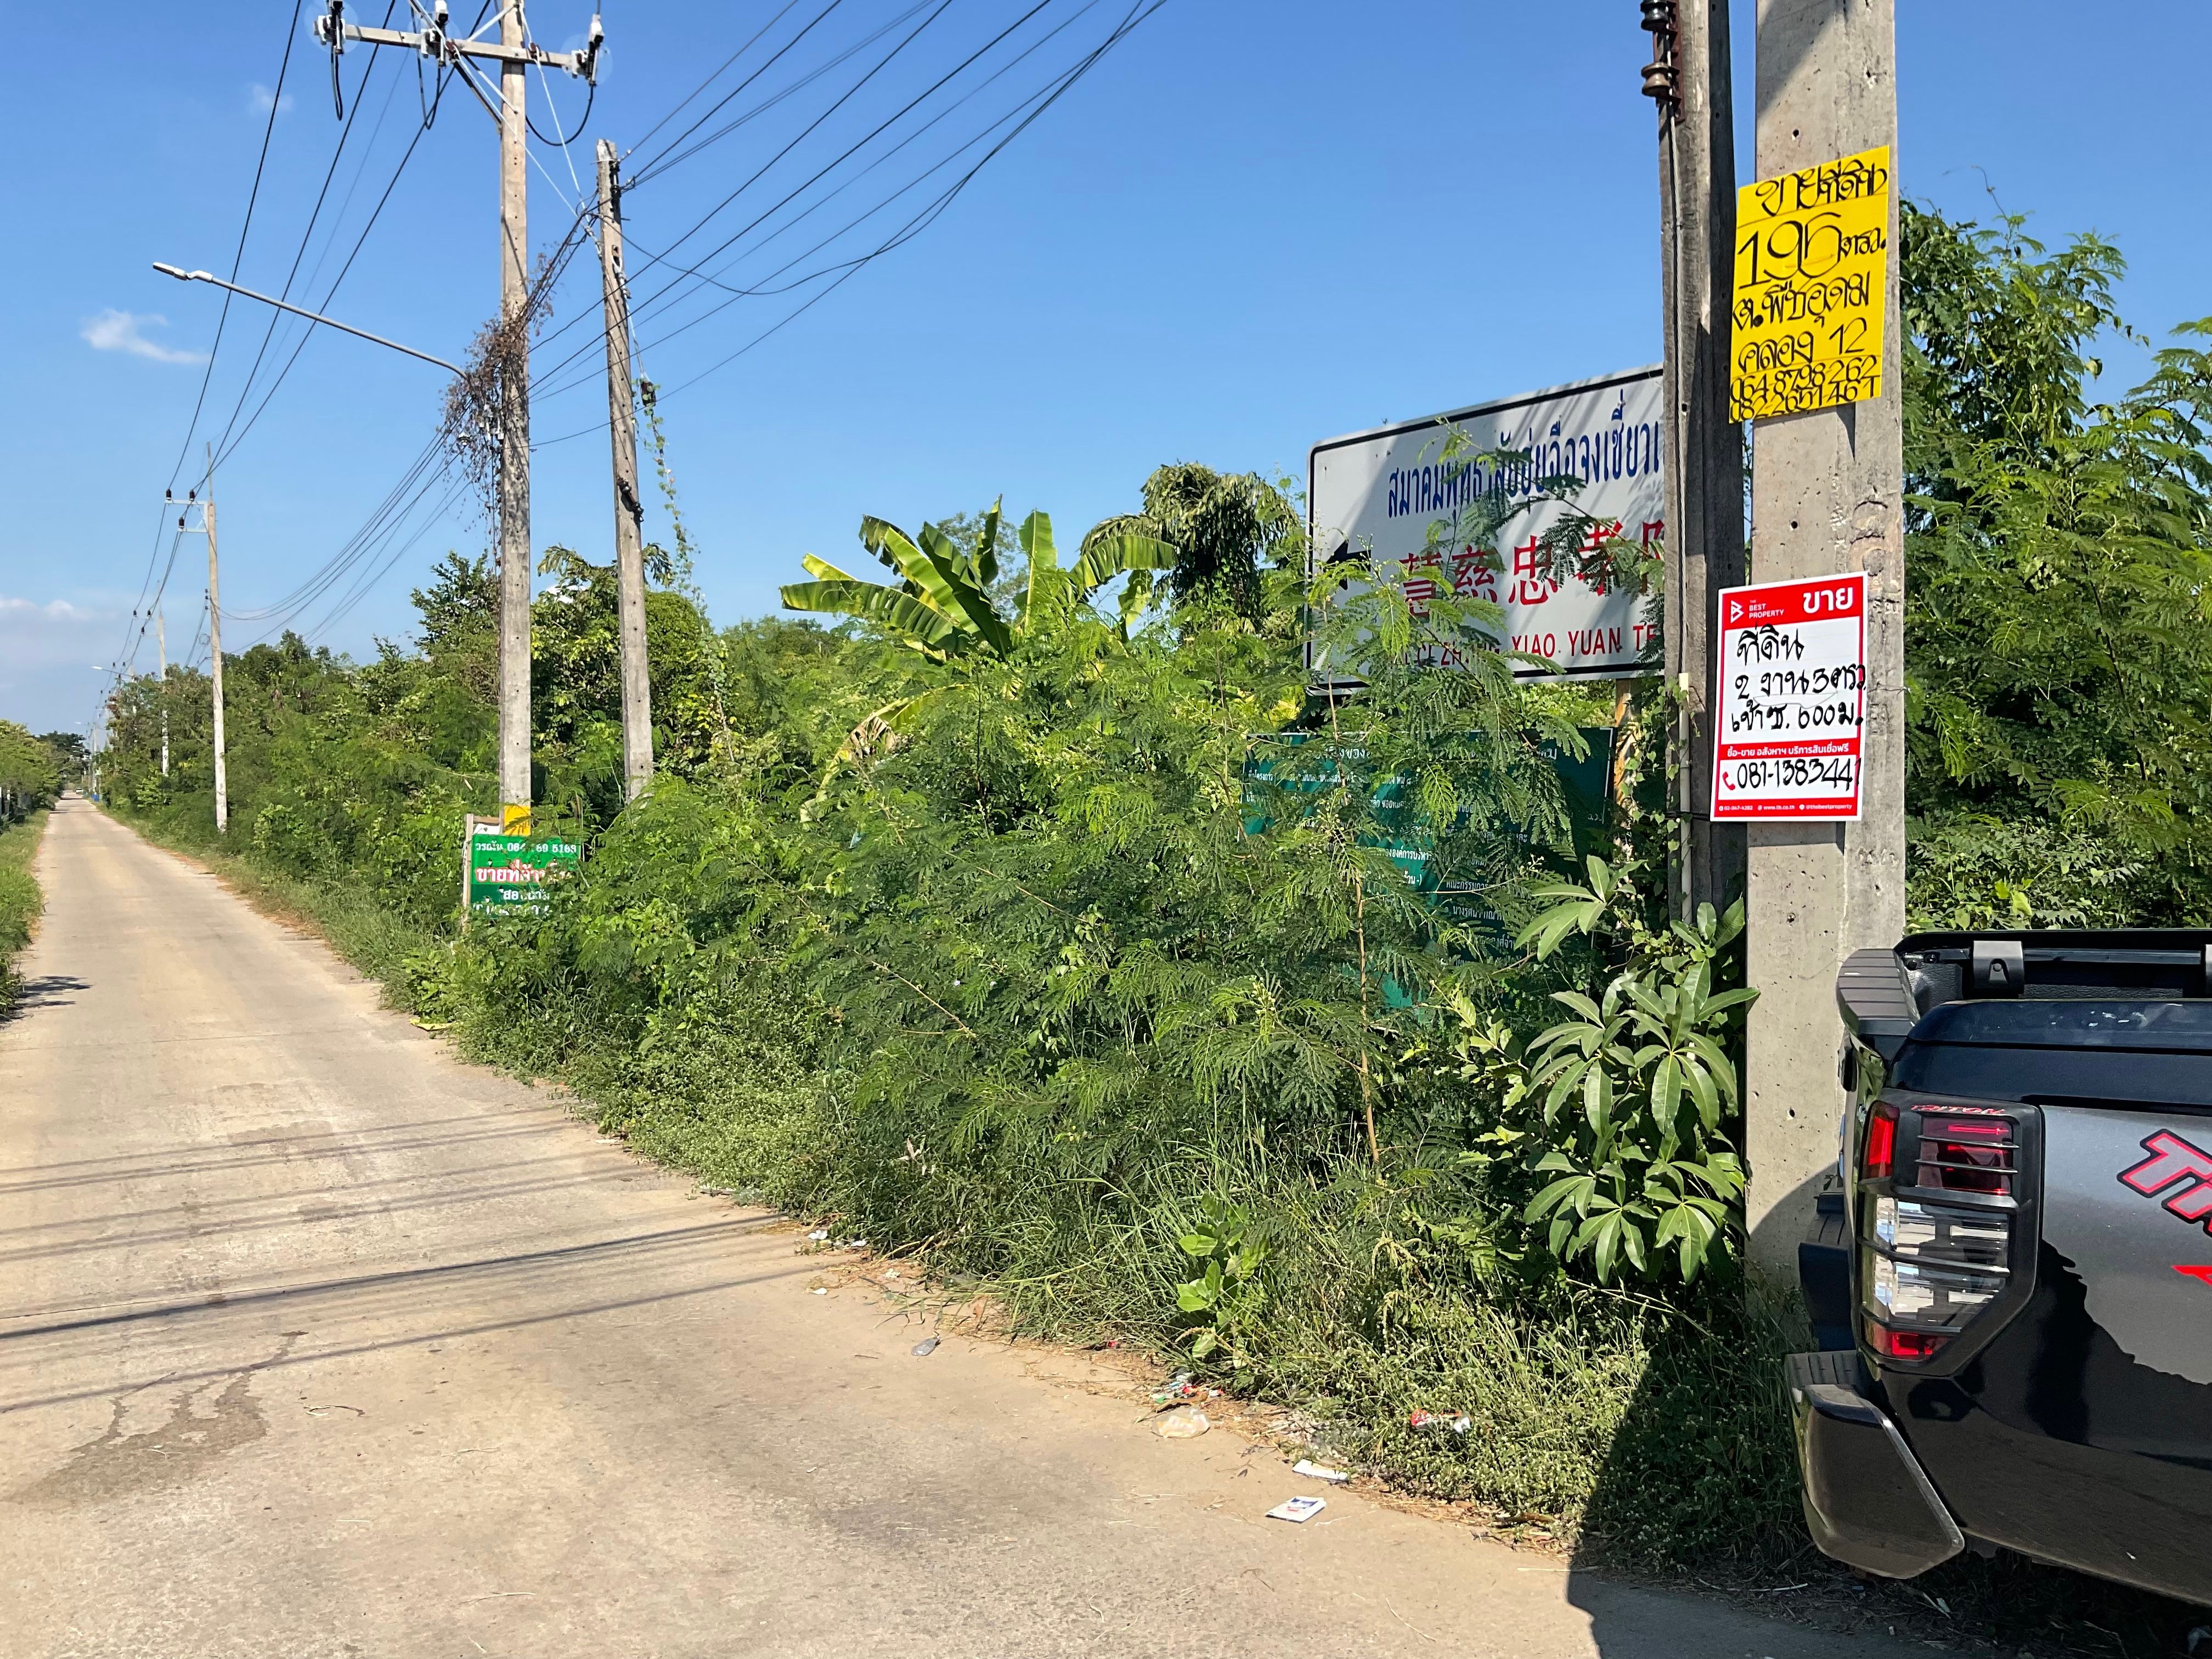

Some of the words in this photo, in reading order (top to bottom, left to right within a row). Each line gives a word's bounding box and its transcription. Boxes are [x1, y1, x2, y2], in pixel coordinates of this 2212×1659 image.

[1738, 331, 1814, 373] คลอง
[1829, 317, 1867, 356] 12
[1749, 603, 1767, 612] BEST
[1749, 609, 1785, 619] PROPERTY
[1803, 587, 1853, 614] ขาย
[1511, 633, 1556, 658] XIAO
[1567, 627, 1621, 656] YUAN
[1737, 621, 1805, 666] ที่ดิน
